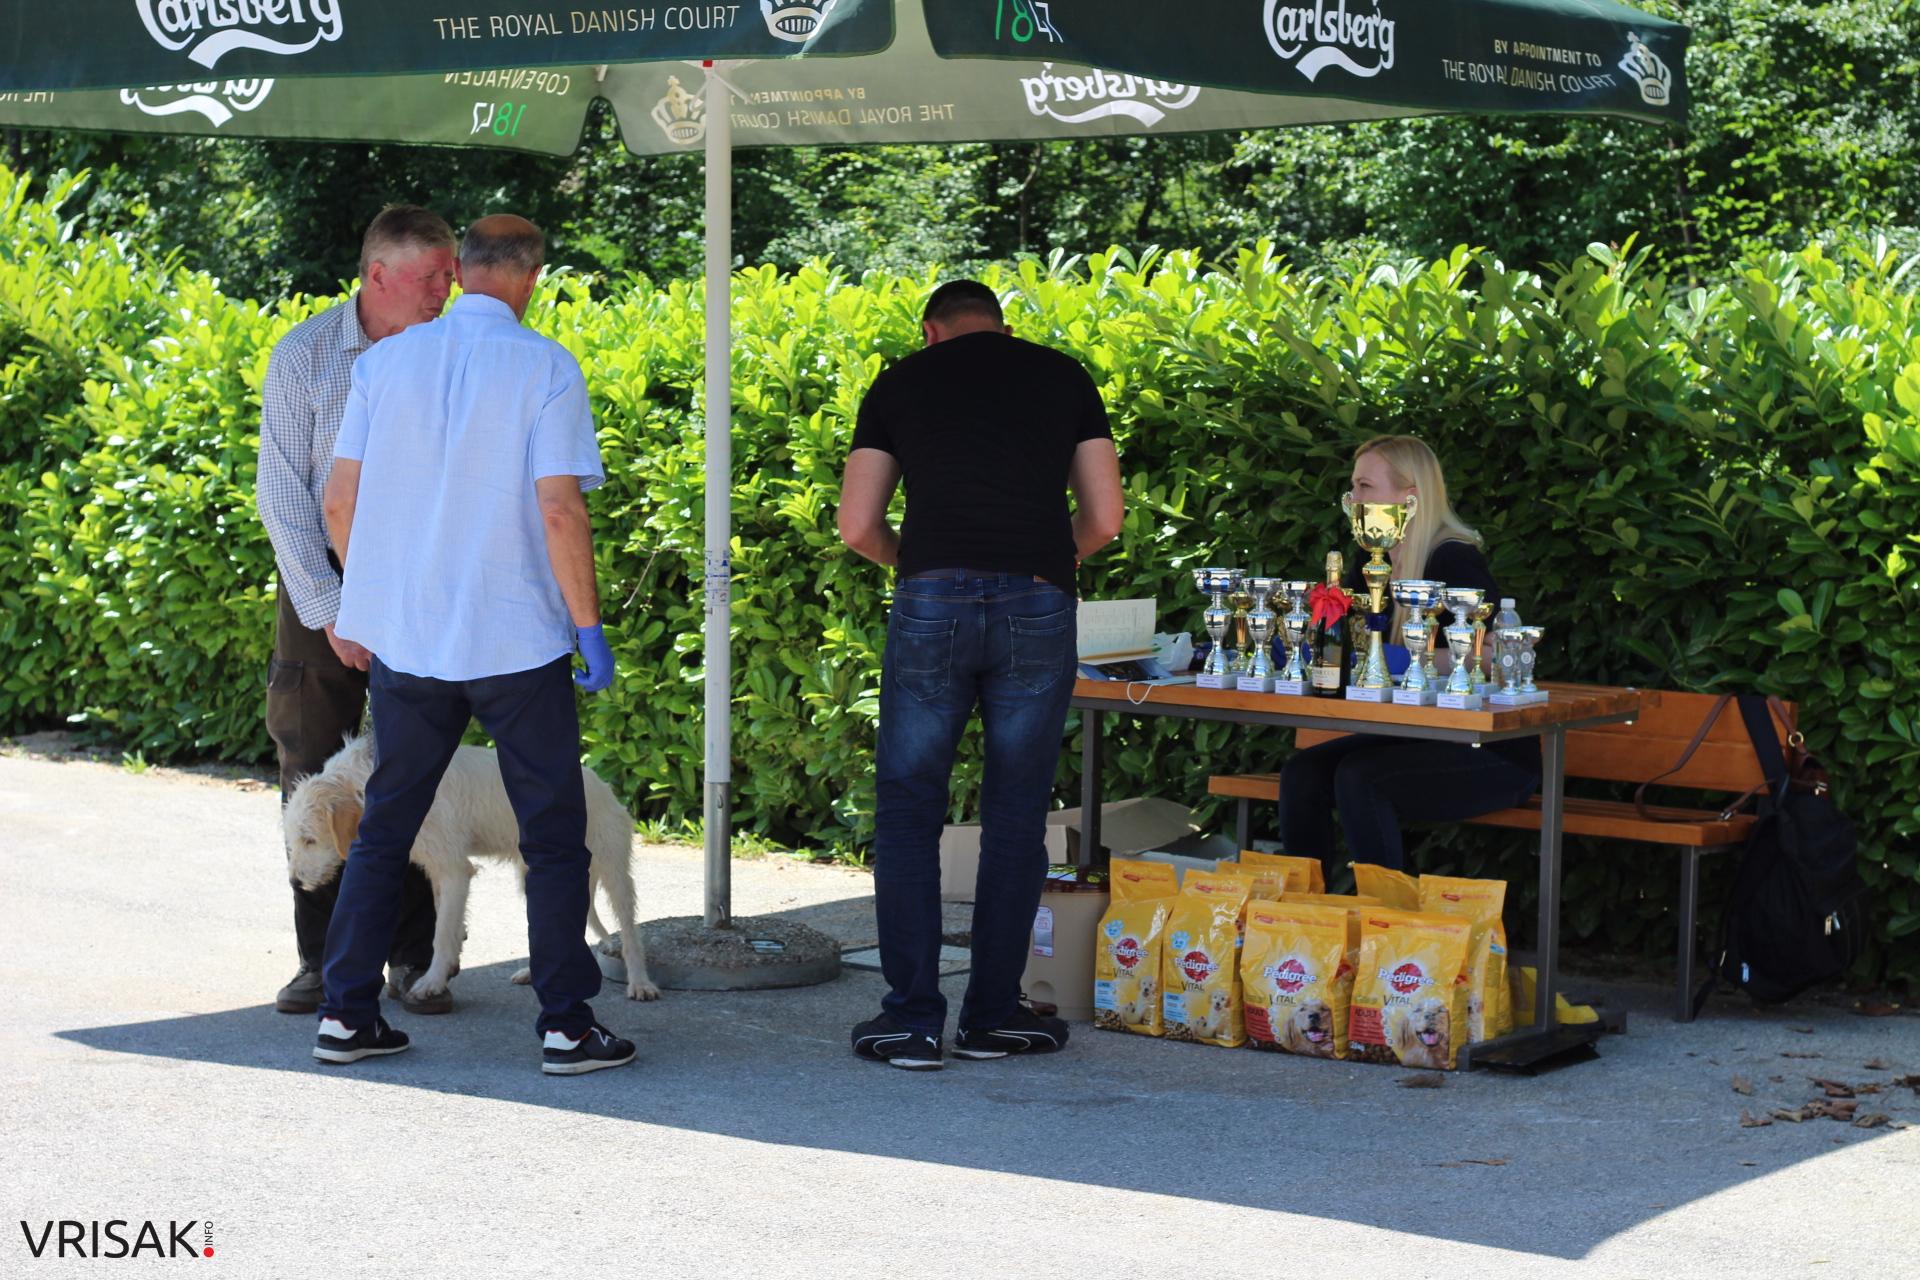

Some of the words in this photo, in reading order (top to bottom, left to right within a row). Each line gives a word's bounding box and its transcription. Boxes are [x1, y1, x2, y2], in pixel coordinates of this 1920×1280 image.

[433, 17, 481, 40] THE
[489, 13, 562, 38] ROYAL
[571, 9, 655, 34] DANISH
[664, 5, 740, 30] COURT
[1263, 0, 1395, 82] Carlsberg
[1494, 39, 1508, 54] BY
[1513, 41, 1581, 65] APPOINTMENT
[1585, 52, 1602, 67] TO
[1442, 59, 1466, 81] THE
[1468, 62, 1508, 85] ROYAL
[1511, 67, 1556, 91] DANISH
[1560, 73, 1617, 93] COURT
[1264, 966, 1317, 984] Pedigree
[1377, 967, 1435, 986] Pedigree
